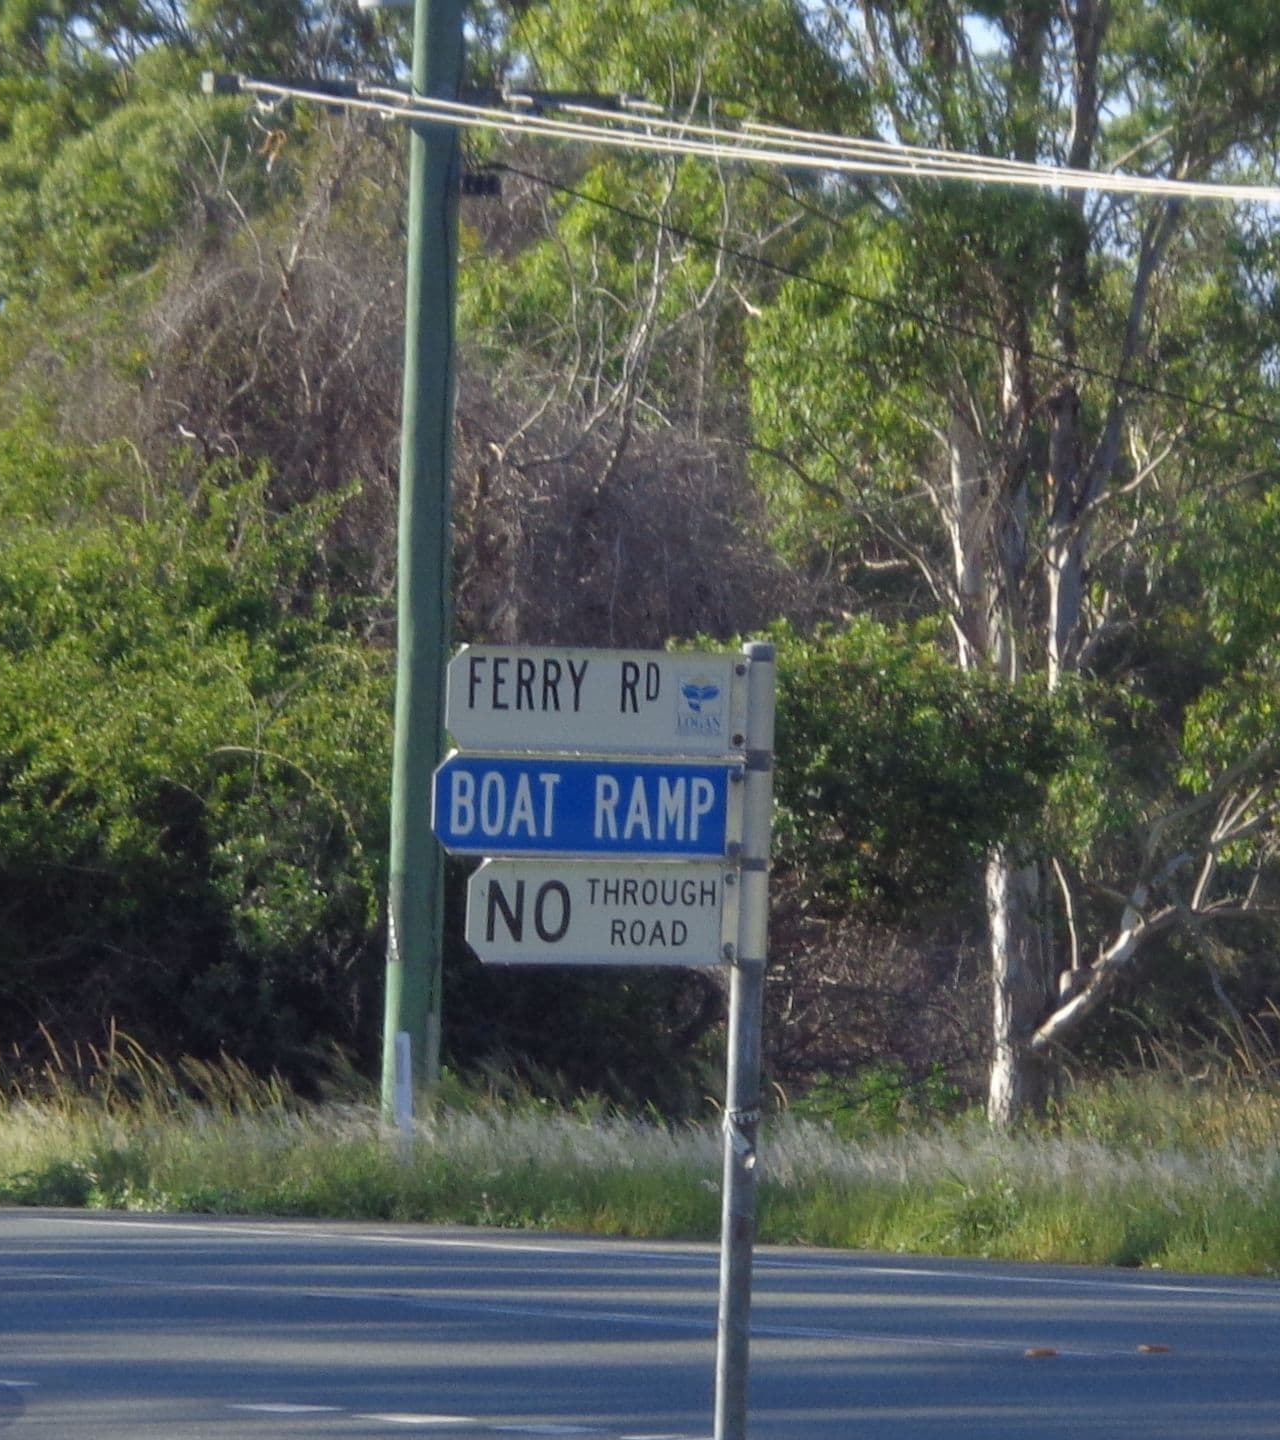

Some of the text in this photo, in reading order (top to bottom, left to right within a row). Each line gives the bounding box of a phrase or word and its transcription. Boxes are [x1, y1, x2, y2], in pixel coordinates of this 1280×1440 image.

[468, 656, 660, 713] FERRY RD
[450, 771, 715, 841] BOAT RAMP
[486, 879, 572, 943] NO
[587, 878, 717, 906] THROUGH
[610, 919, 688, 946] ROAD
